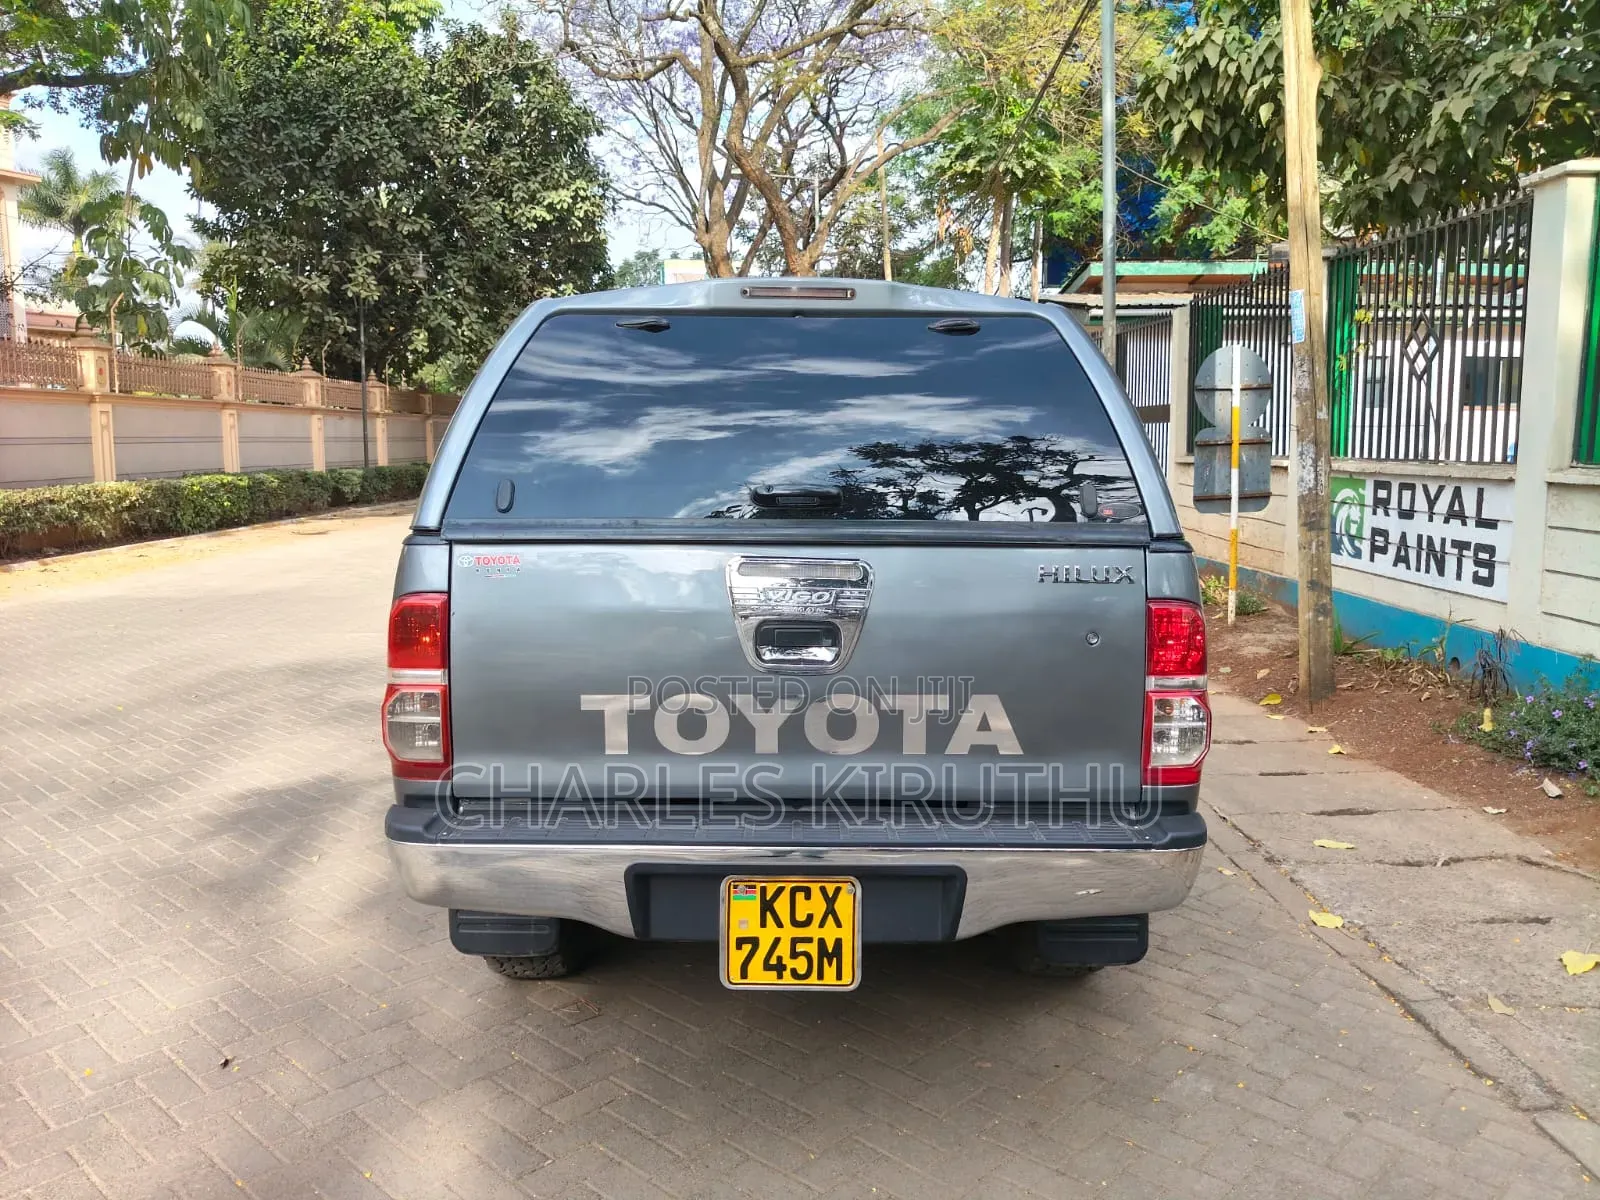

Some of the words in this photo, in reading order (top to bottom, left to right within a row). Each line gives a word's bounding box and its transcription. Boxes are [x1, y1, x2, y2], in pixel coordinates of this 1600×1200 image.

[1372, 479, 1498, 530] ROYAL
[475, 555, 520, 565] TOYOTA
[1038, 565, 1135, 584] HILUX
[1369, 526, 1497, 588] PAINTS
[580, 693, 1024, 755] TOYOTA
[760, 885, 843, 929] KCX
[735, 936, 843, 981] 745M
